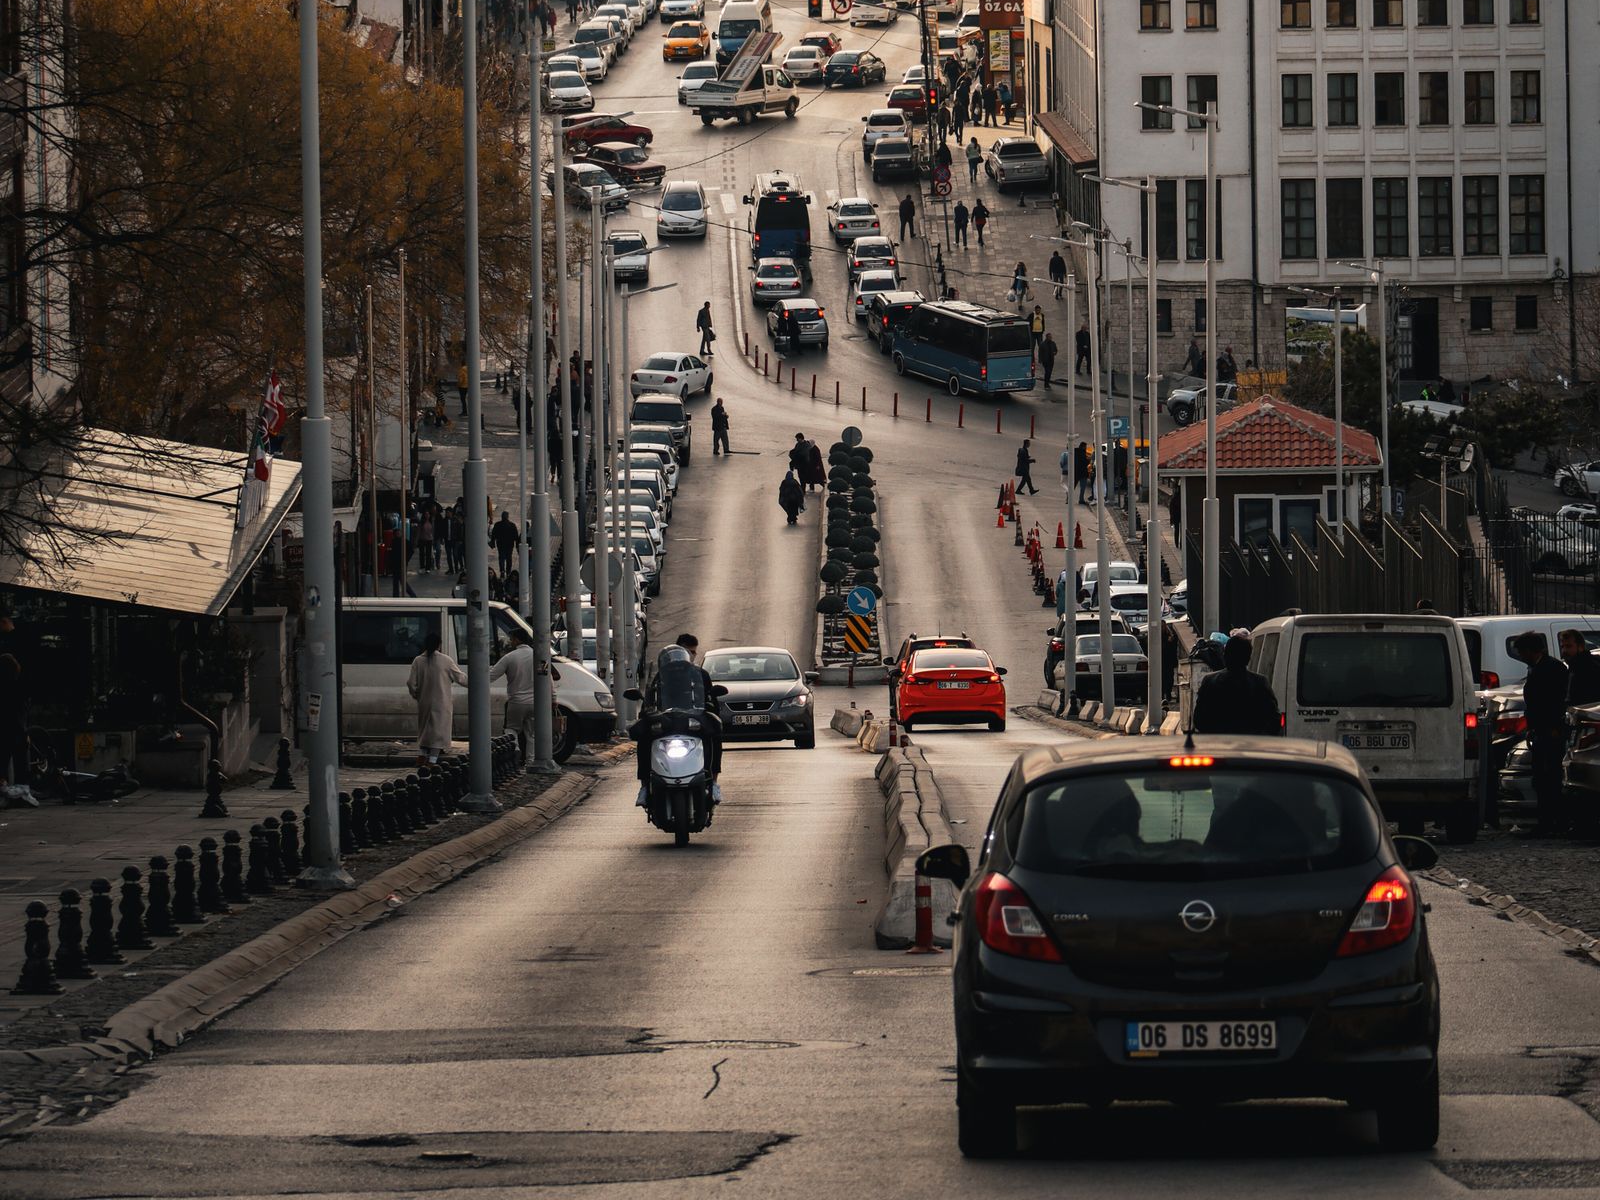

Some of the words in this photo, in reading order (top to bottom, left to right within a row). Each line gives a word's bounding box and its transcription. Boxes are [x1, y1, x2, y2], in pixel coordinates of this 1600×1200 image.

[984, 0, 1001, 12] ÖZ
[1110, 419, 1122, 434] P
[1349, 735, 1361, 747] 06
[1390, 736, 1408, 747] 076
[1141, 1024, 1166, 1048] 06
[1182, 1023, 1208, 1048] DS
[1220, 1023, 1272, 1047] 8699
